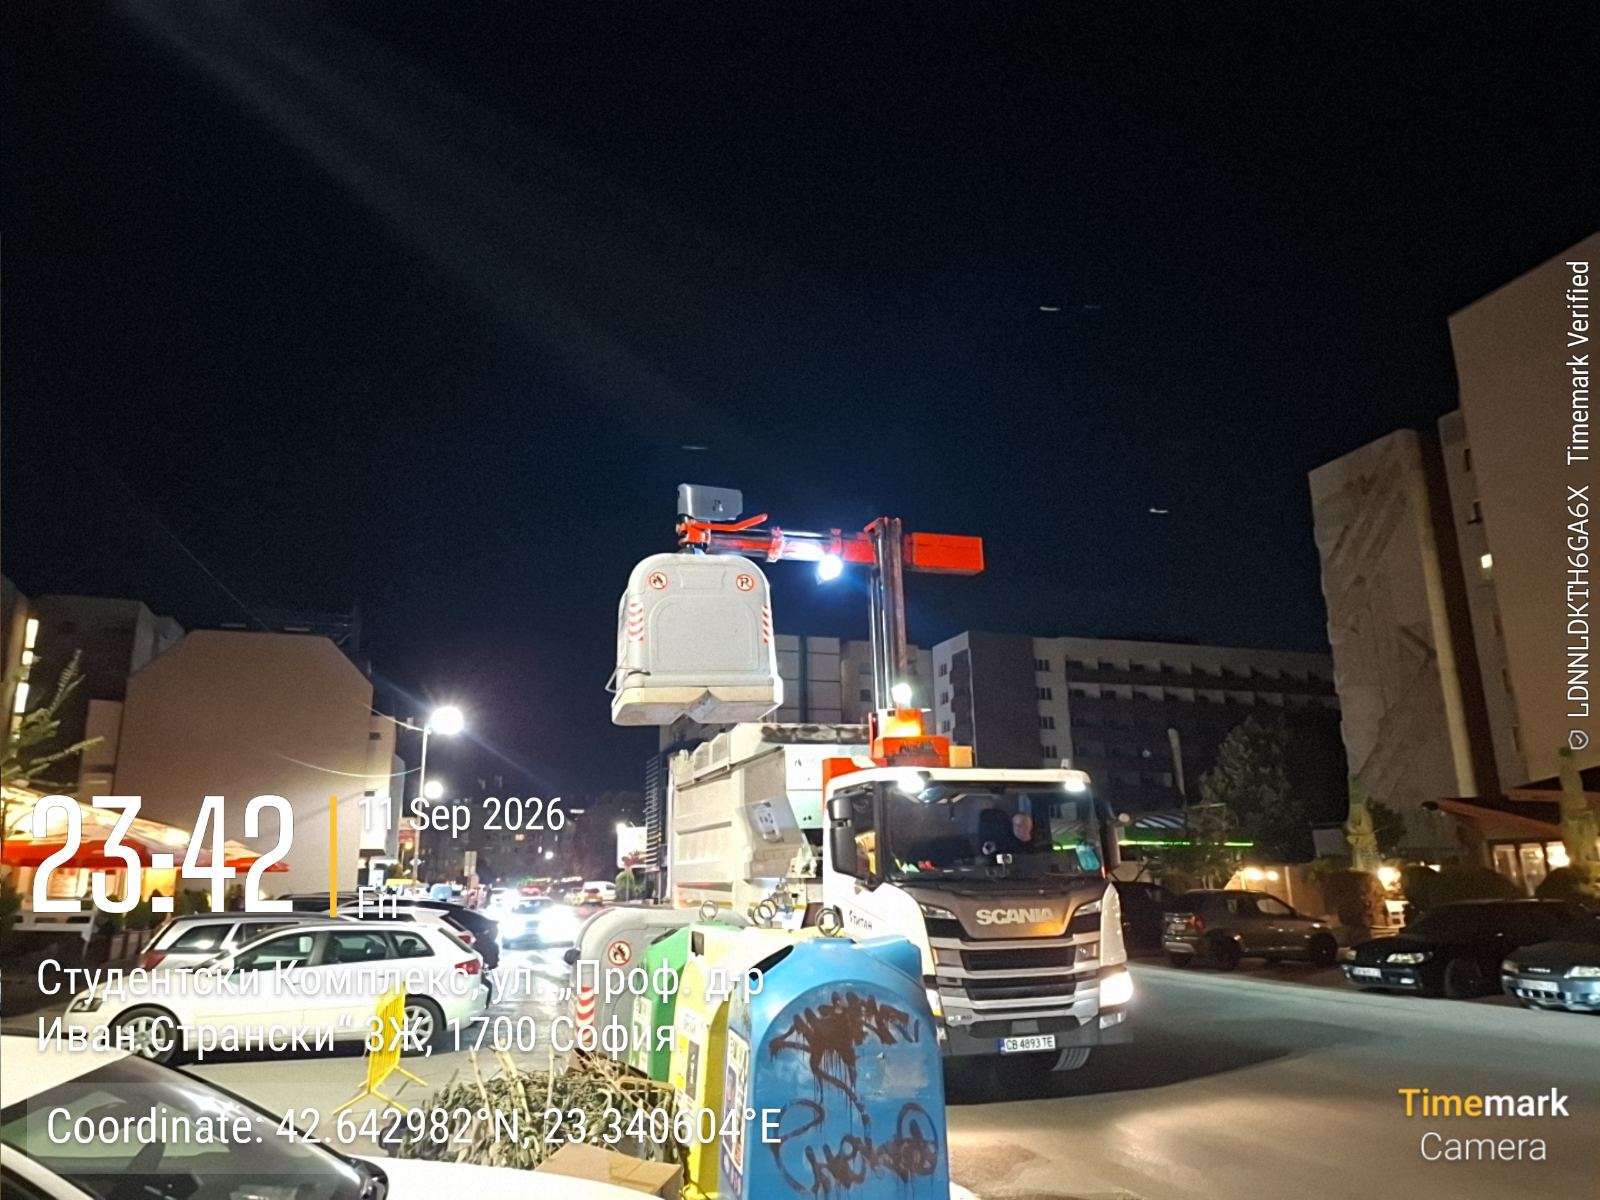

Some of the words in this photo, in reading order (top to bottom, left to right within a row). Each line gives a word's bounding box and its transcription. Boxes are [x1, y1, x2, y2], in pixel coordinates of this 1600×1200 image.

[976, 908, 1055, 925] SCANIA
[1020, 1038, 1041, 1049] 4893
[1042, 1036, 1053, 1047] TE
